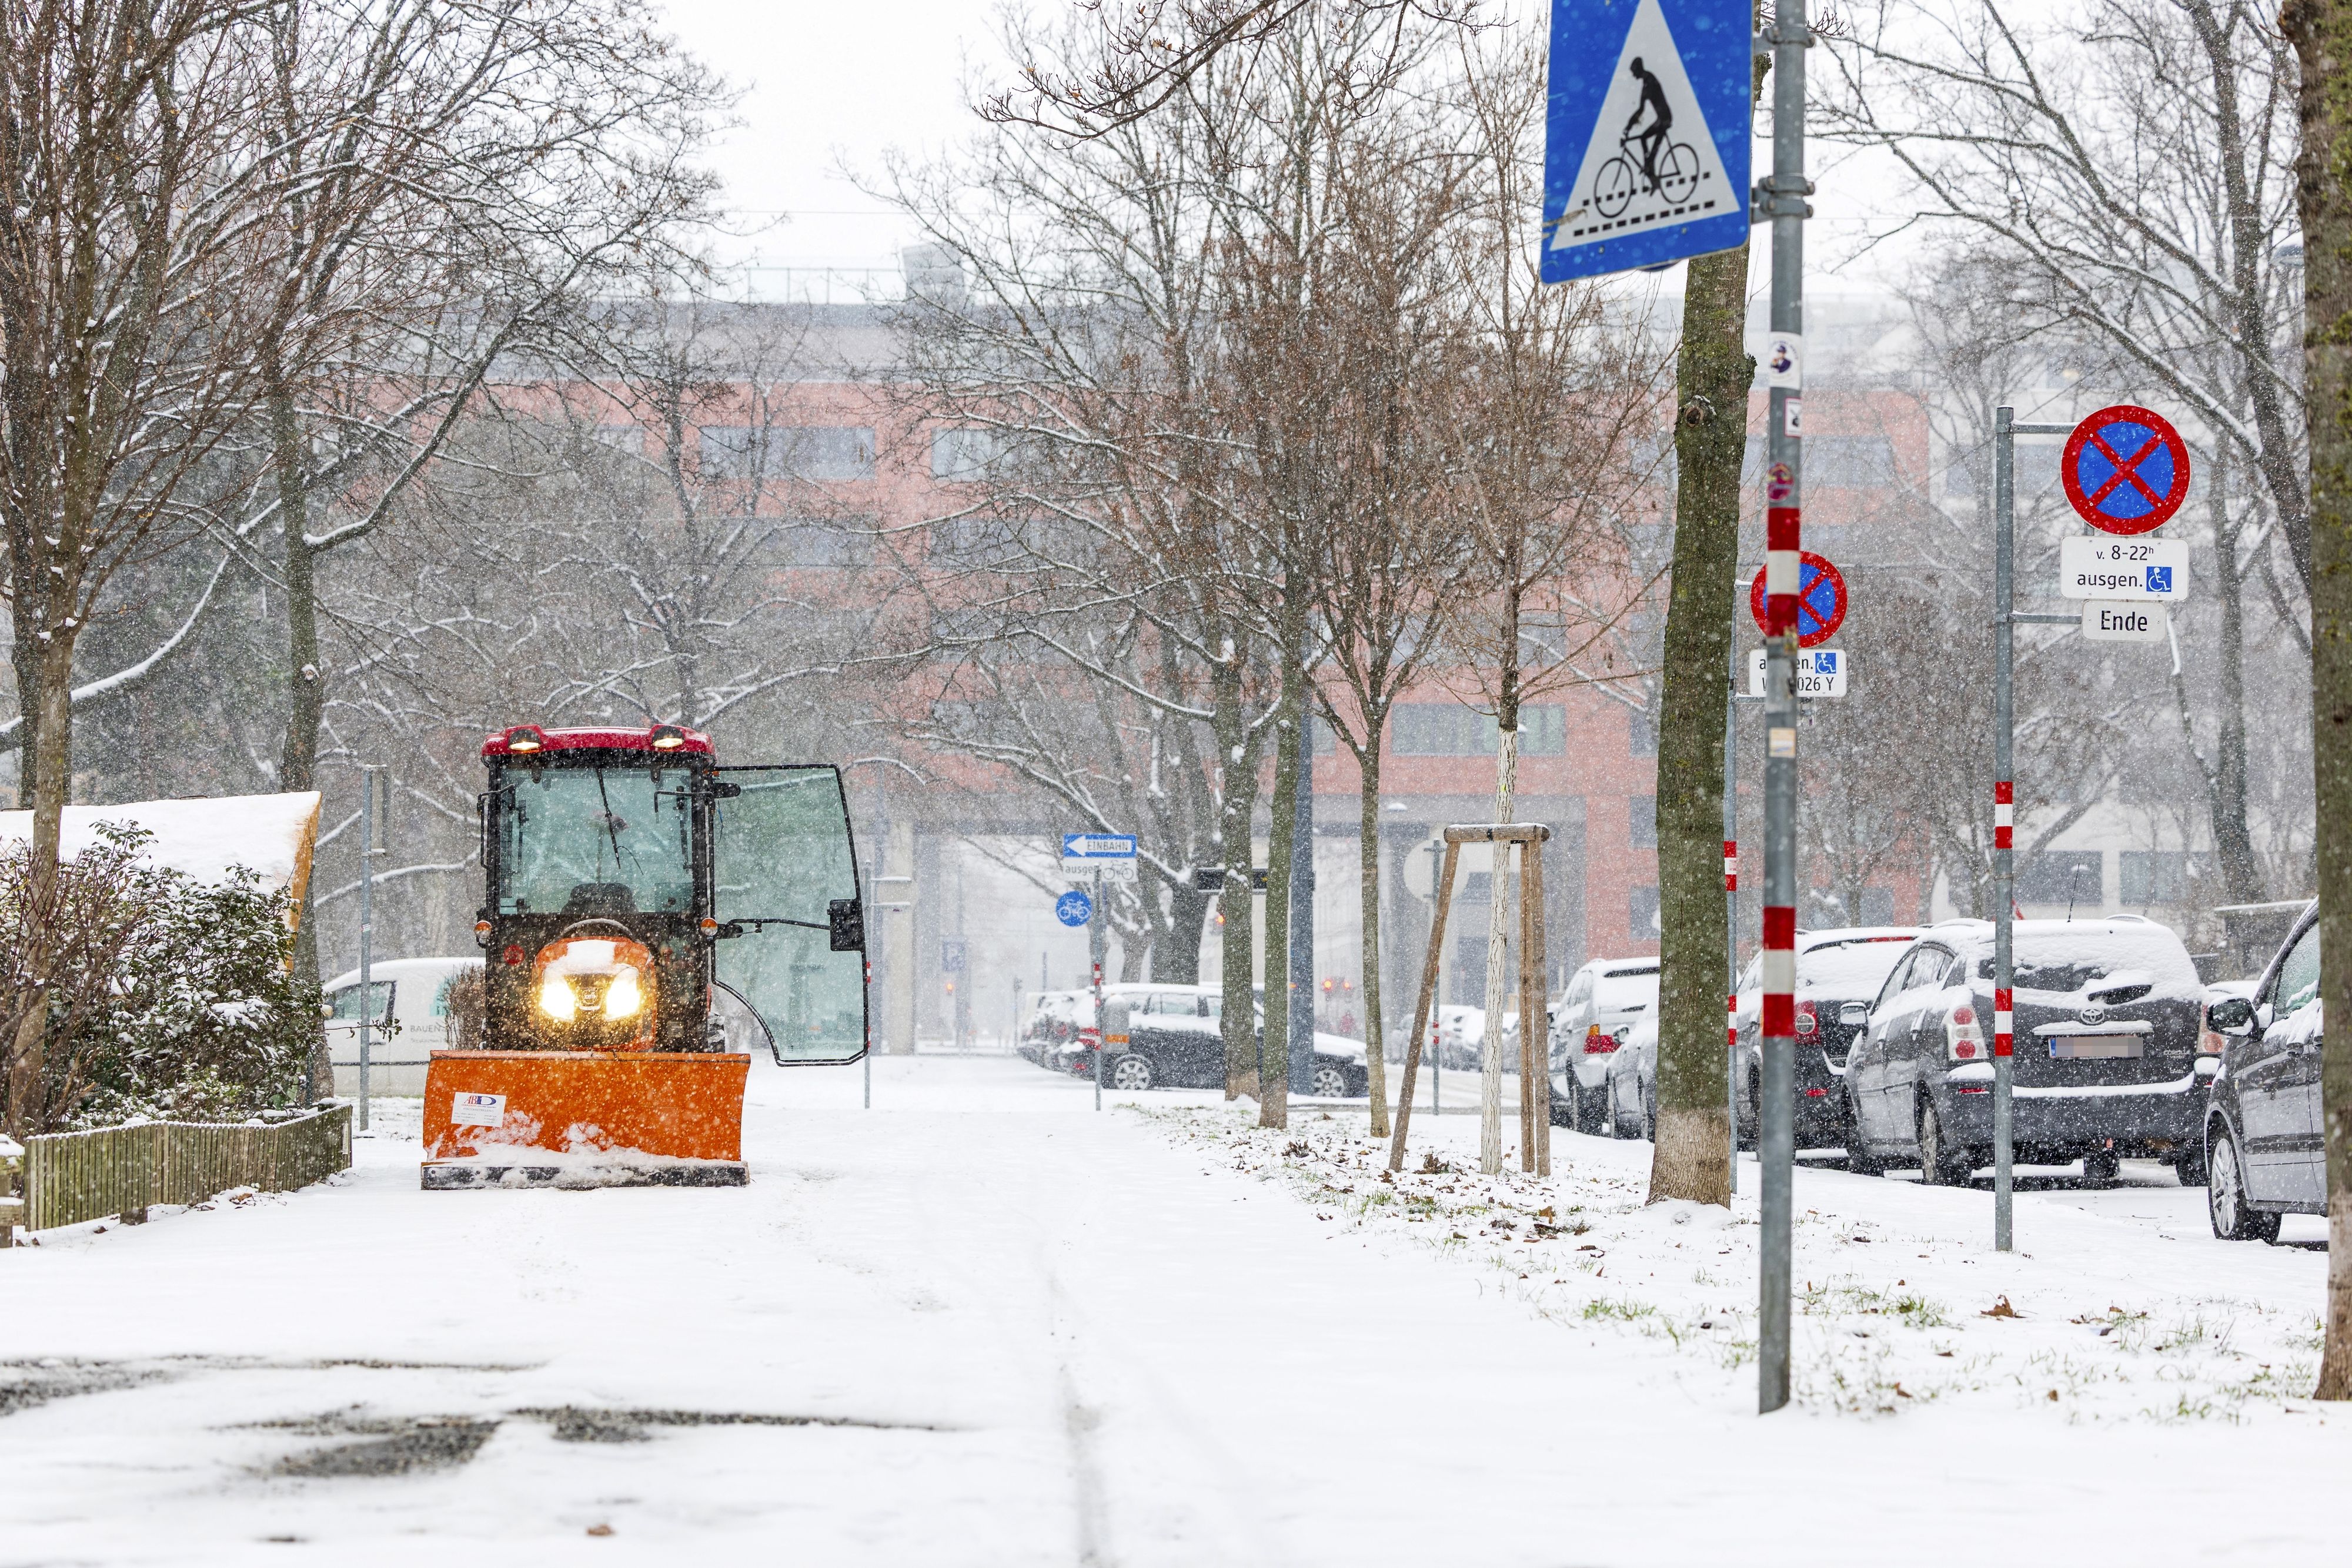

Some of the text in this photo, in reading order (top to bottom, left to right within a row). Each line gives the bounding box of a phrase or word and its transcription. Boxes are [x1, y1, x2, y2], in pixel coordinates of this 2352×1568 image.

[2096, 551, 2105, 559] v.
[2077, 574, 2143, 590] ausgen.
[2100, 610, 2148, 631] Ende
[1759, 658, 1813, 670] aen.
[1826, 677, 1835, 691] Y
[1088, 841, 1128, 851] EINBAHN
[1065, 865, 1095, 876] ausge
[463, 1095, 497, 1105] ABD
